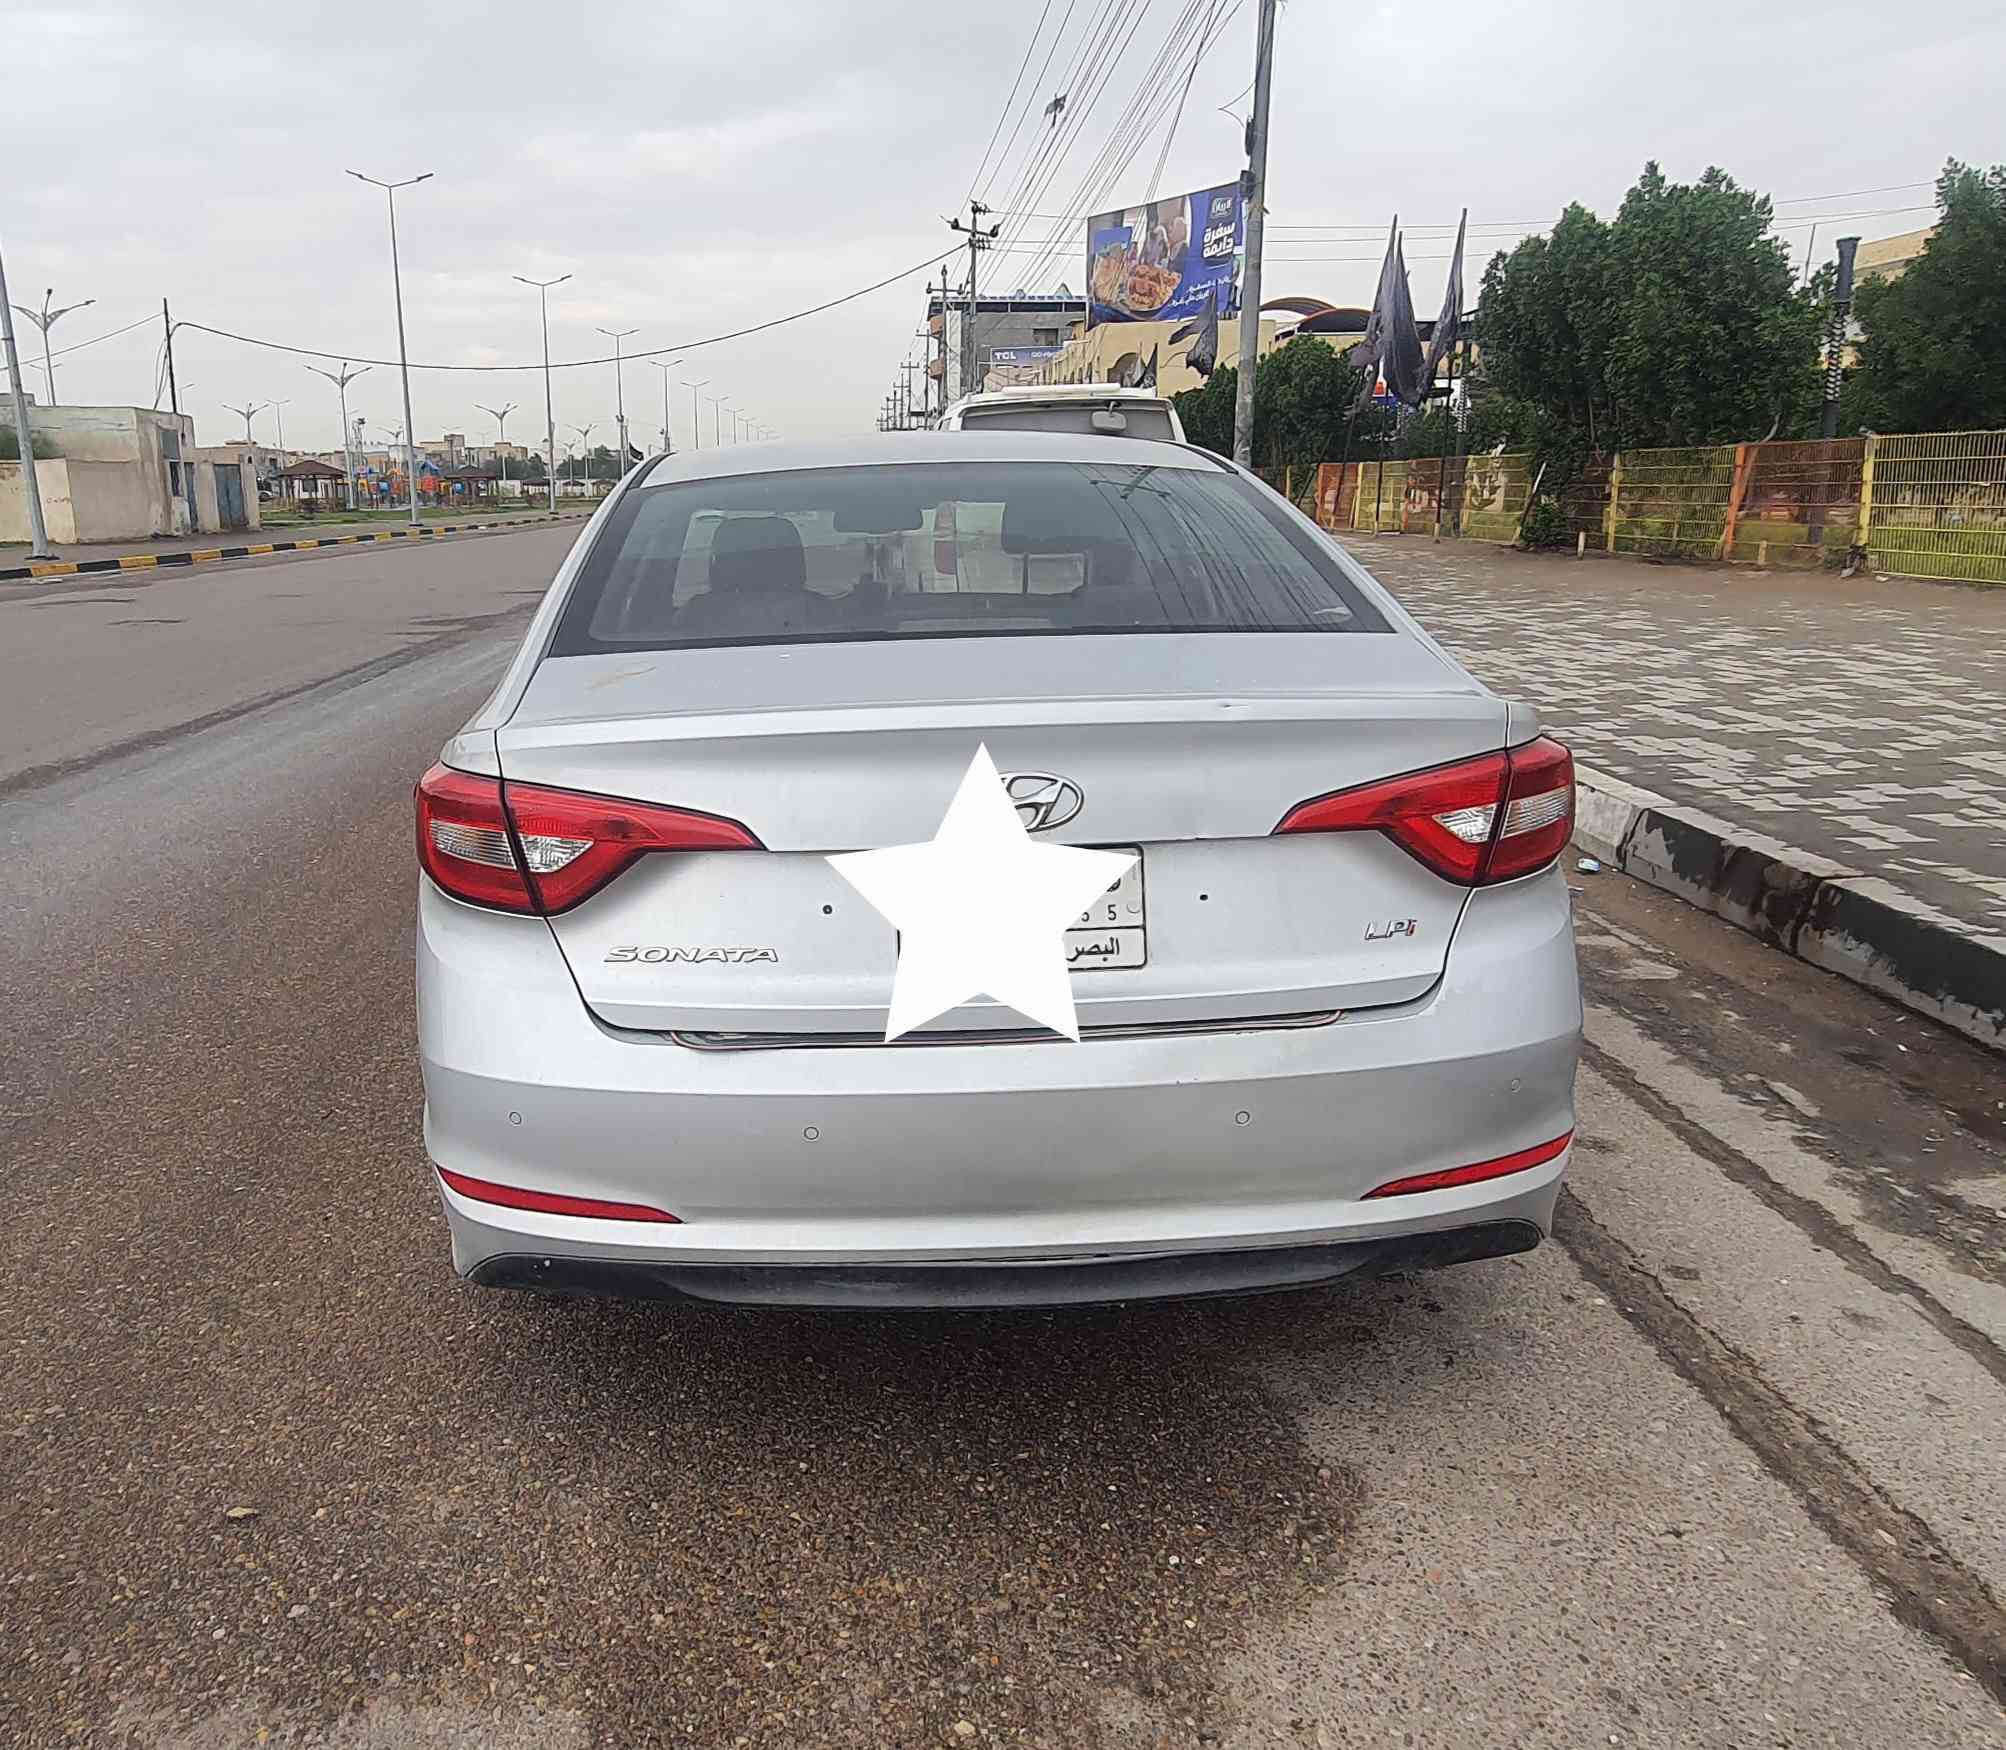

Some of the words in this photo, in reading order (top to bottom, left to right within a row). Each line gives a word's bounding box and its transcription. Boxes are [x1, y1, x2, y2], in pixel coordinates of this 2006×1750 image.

[994, 351, 1017, 360] TCL
[603, 946, 779, 963] SONATA
[1065, 936, 1120, 962] البصر
